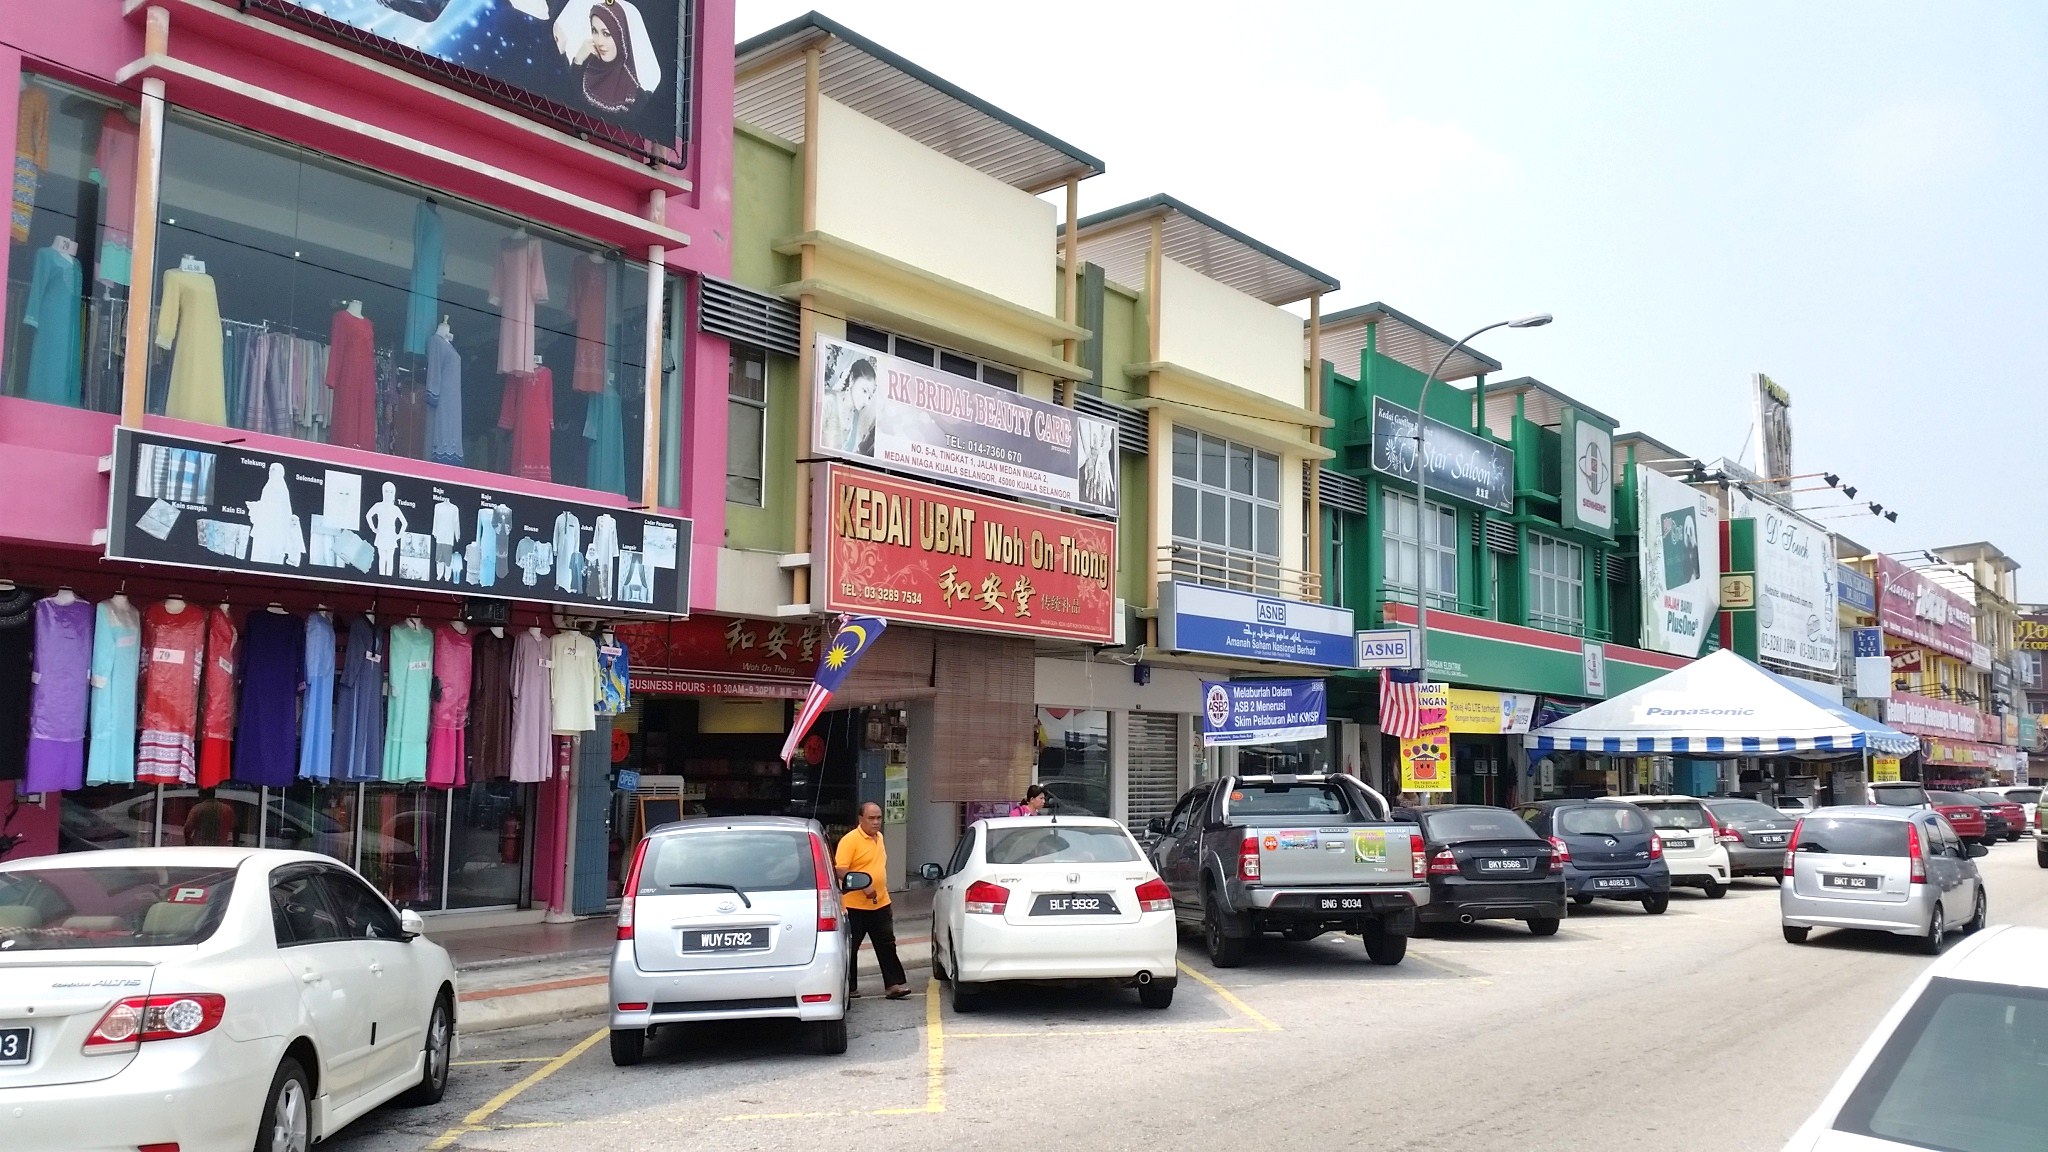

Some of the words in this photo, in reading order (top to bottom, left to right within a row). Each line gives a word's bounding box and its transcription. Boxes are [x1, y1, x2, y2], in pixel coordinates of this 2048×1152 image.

[887, 368, 911, 404] RK
[915, 378, 973, 423] BRIDAL
[975, 393, 1032, 438] BEAUTY
[1034, 410, 1072, 448] CARE
[945, 433, 965, 450] TEL:
[968, 438, 1005, 459] 014-7360
[1007, 449, 1022, 463] 670
[240, 457, 266, 469] Telekung
[911, 443, 924, 455] NO.
[939, 449, 968, 465] TINGKAT
[977, 458, 998, 473] JALAN
[999, 464, 1021, 478] MEDAN
[1022, 468, 1041, 482] NIAGA
[1423, 441, 1450, 473] Star
[1451, 449, 1491, 485] Saloon
[884, 450, 910, 467] MEDAN
[911, 456, 934, 471] NIAGA
[935, 461, 958, 477] KUALA
[959, 466, 997, 487] SELANGOR,
[998, 476, 1015, 490] 45000
[1016, 480, 1038, 495] KUALA
[1038, 484, 1071, 501] SELANGOR
[433, 486, 445, 495] Baju
[481, 493, 492, 501] Baju
[186, 503, 207, 513] sampin
[222, 505, 235, 514] Kain
[235, 506, 246, 515] Ela
[398, 499, 416, 509] Tudung
[523, 524, 539, 533] Blouse
[838, 482, 912, 548] KEDAI
[919, 498, 976, 557] UBAT
[983, 521, 1025, 567] Woh
[1030, 529, 1055, 572] On
[1060, 535, 1109, 590] Thong
[841, 582, 858, 597] TEL
[864, 586, 877, 601] 03
[877, 588, 899, 603] 3289
[901, 591, 922, 605] 7534
[938, 565, 1037, 618] 和安堂
[1259, 604, 1285, 621] ASNB
[567, 648, 576, 656] 29
[1226, 636, 1251, 648] Amanah
[1251, 639, 1272, 650] Saham
[1272, 642, 1296, 654] Nasional
[1297, 645, 1316, 656] Berhad
[1364, 642, 1404, 657] ASNB
[158, 651, 171, 660] 79
[742, 662, 760, 672] Woh
[761, 663, 773, 673] On
[774, 664, 796, 676] Thong
[629, 679, 673, 691] BUSINESS
[675, 681, 706, 693] HOURS
[1233, 686, 1271, 698] Melaburlah
[1272, 687, 1293, 697] Dalam
[1209, 701, 1229, 713] ASB2
[1234, 701, 1249, 713] ASB
[1250, 701, 1255, 712] 2
[1256, 700, 1286, 712] Menerusi
[1464, 702, 1472, 712] 4G
[1472, 703, 1481, 713] LTE
[1646, 707, 1754, 716] Panasonic
[1234, 715, 1252, 727] Skim
[1253, 715, 1286, 726] Pelaburan
[1299, 711, 1320, 723] KWSP
[620, 773, 636, 786] OPEN
[886, 799, 905, 807] TANGAN
[1488, 860, 1502, 869] BKY
[1598, 879, 1608, 887] WB
[1834, 876, 1848, 885] BKT
[1851, 878, 1866, 887] 1021
[175, 888, 204, 902] P
[1050, 899, 1070, 910] BLF
[1071, 899, 1100, 910] 9932
[1321, 899, 1337, 909] BNG
[1341, 898, 1362, 909] 9034
[701, 933, 723, 947] WUY
[724, 932, 752, 946] 5792
[92, 979, 142, 987] ALTIS
[0, 1034, 19, 1058] 3
